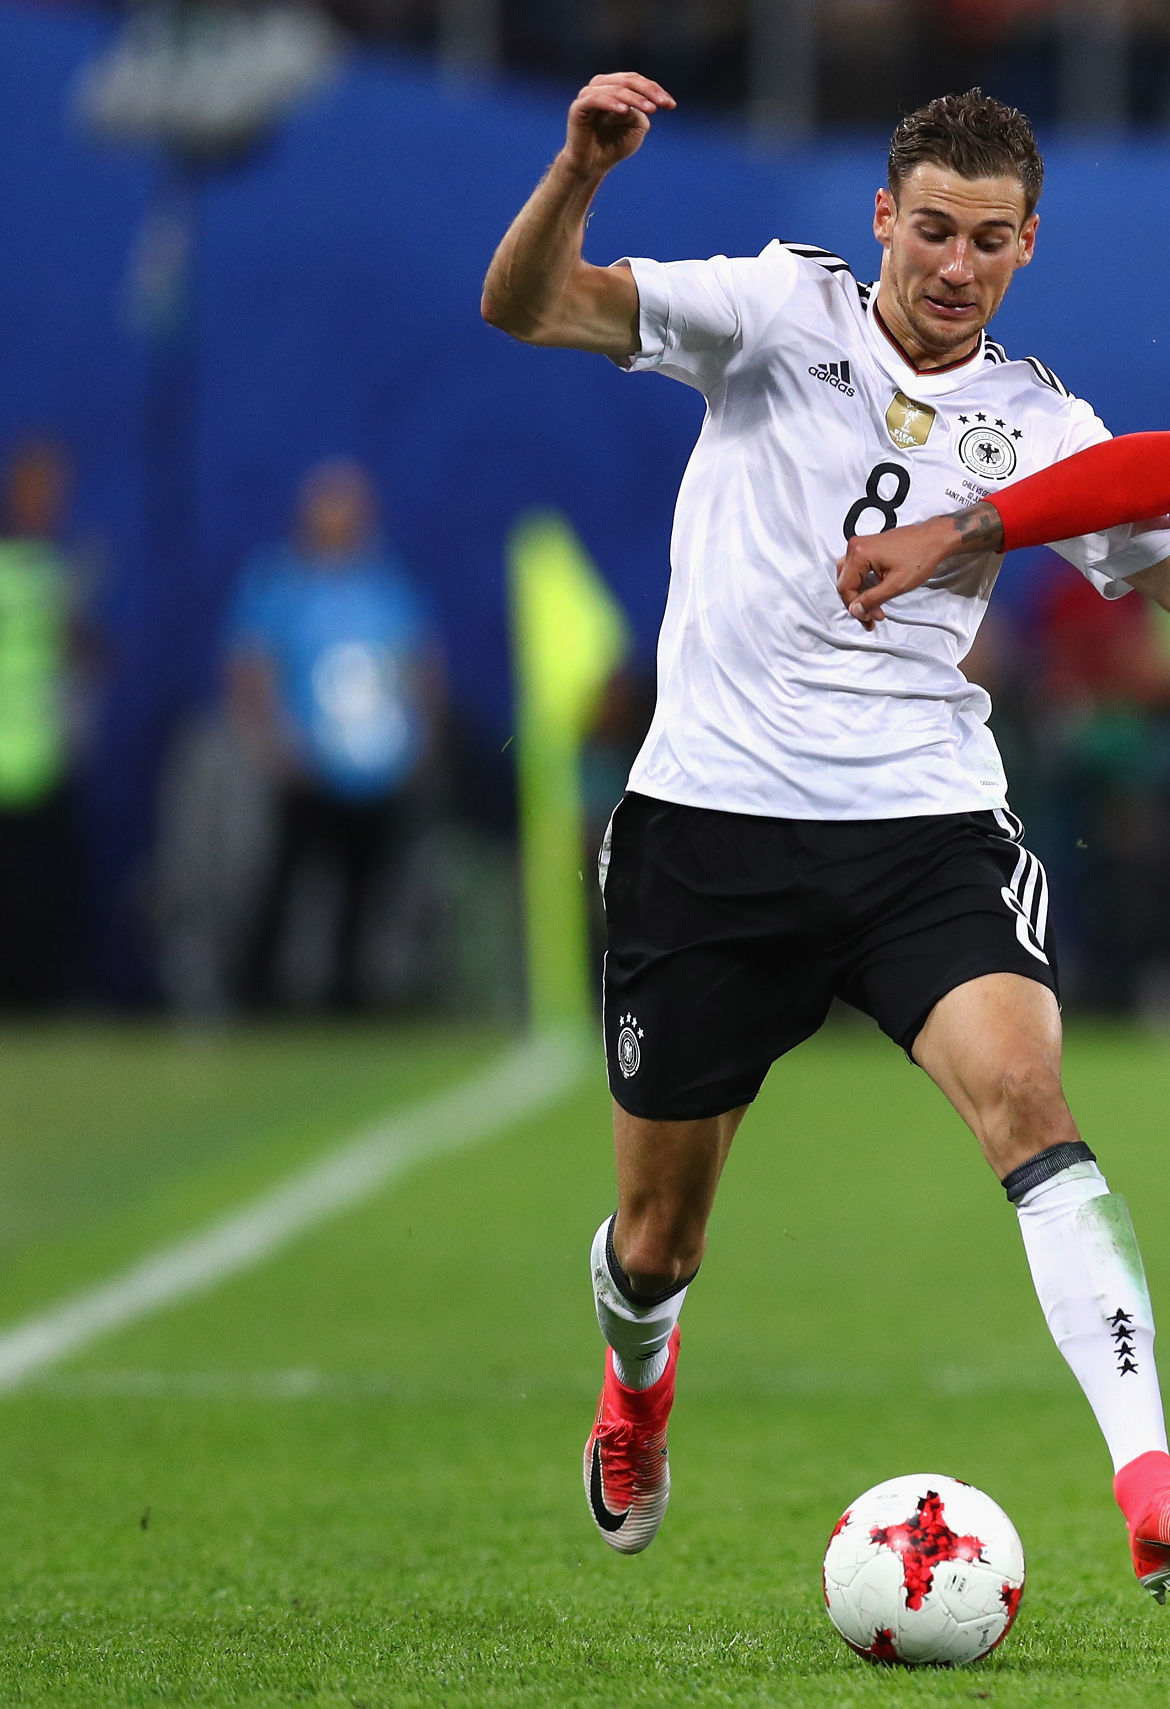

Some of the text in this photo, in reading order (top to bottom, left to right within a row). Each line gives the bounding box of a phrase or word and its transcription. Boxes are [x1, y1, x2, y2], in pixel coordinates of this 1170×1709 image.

[808, 366, 856, 398] adidas
[945, 488, 960, 501] SAINT
[962, 479, 976, 491] CHILE
[843, 462, 911, 542] 8
